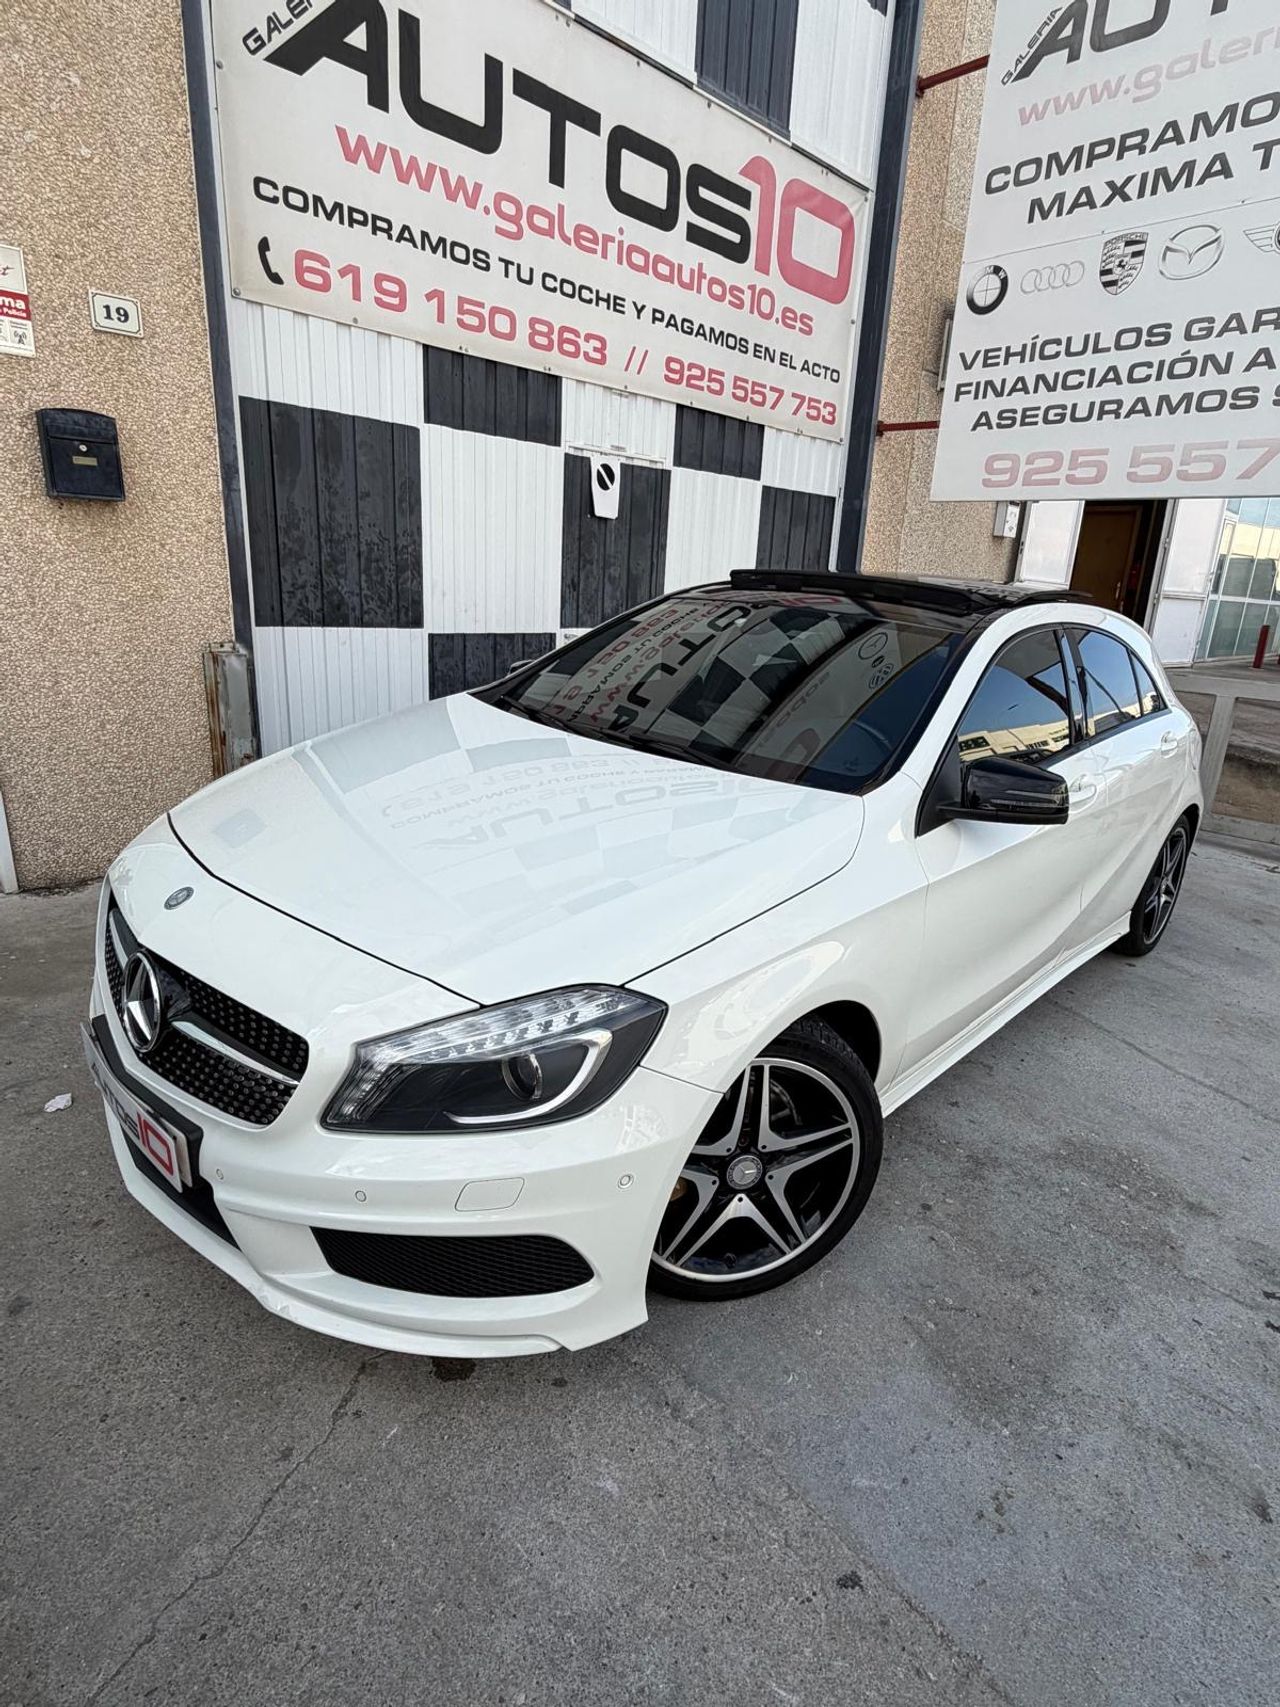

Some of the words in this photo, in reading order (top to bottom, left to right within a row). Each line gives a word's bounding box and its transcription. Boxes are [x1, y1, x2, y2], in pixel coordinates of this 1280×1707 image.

[242, 0, 314, 56] GALE
[1000, 7, 1064, 86] GALERIA
[263, 0, 856, 305] AUTOS10
[1027, 152, 1234, 224] MAXIMA
[334, 124, 814, 337] www.galeriaautos10.es
[252, 175, 491, 272] COMPRAMOS
[498, 255, 534, 286] TU
[541, 271, 627, 315] COCHE
[632, 300, 647, 321] Y
[651, 308, 749, 355] PAGAMOS
[752, 343, 776, 364] EN
[779, 352, 797, 371] EL
[799, 358, 841, 384] ACTO
[102, 304, 130, 324] 19
[293, 248, 408, 313] 619
[424, 288, 517, 342] 150
[528, 316, 608, 367] 863
[663, 355, 726, 397] 925
[731, 374, 786, 411] 557
[790, 392, 837, 426] 753
[953, 349, 1235, 403] FINANCIACIÓN
[1241, 346, 1278, 374] A
[958, 322, 1173, 372] VEHÍCULOS
[970, 385, 1261, 432] ASEGURAMOS
[981, 447, 1110, 489] 925
[1126, 437, 1280, 484] 557
